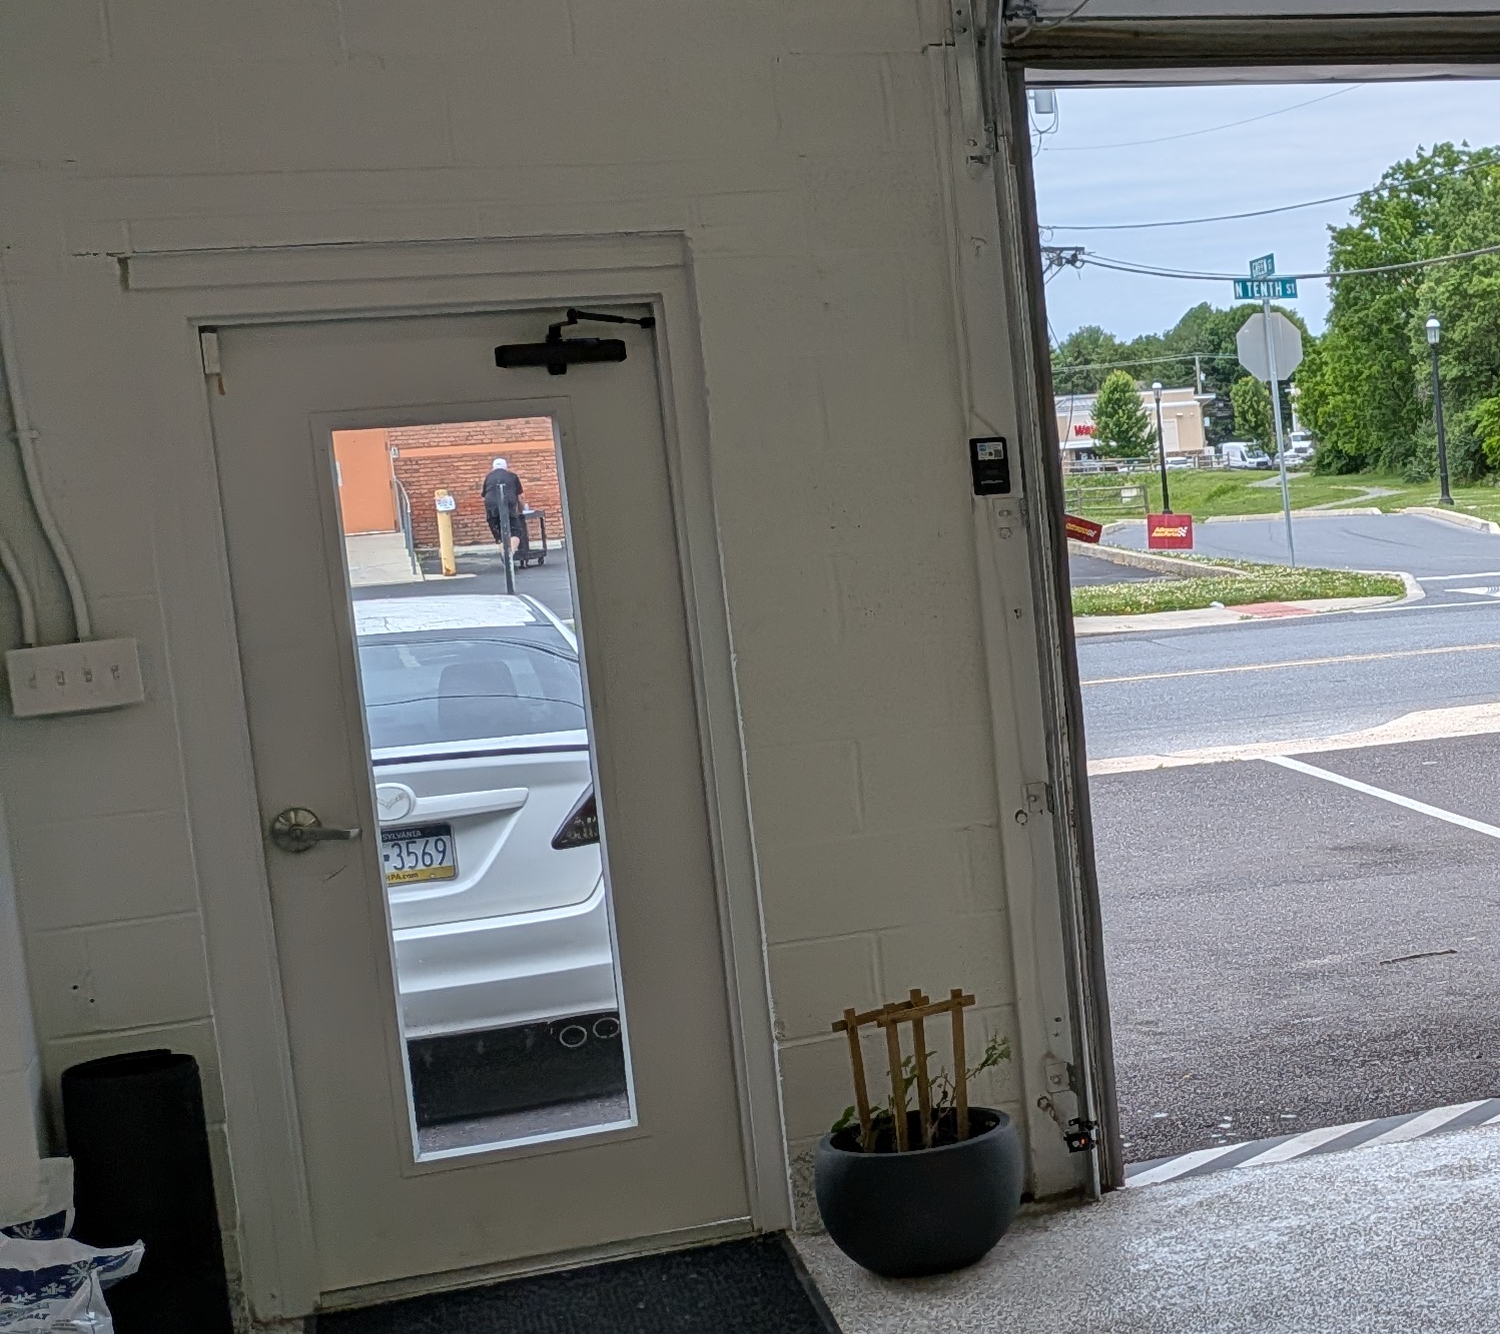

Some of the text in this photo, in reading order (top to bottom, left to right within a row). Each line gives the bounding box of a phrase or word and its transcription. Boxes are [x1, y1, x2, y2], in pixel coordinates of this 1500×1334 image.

[1235, 281, 1295, 297] N TENTH ST
[383, 831, 422, 840] SYLVANIA
